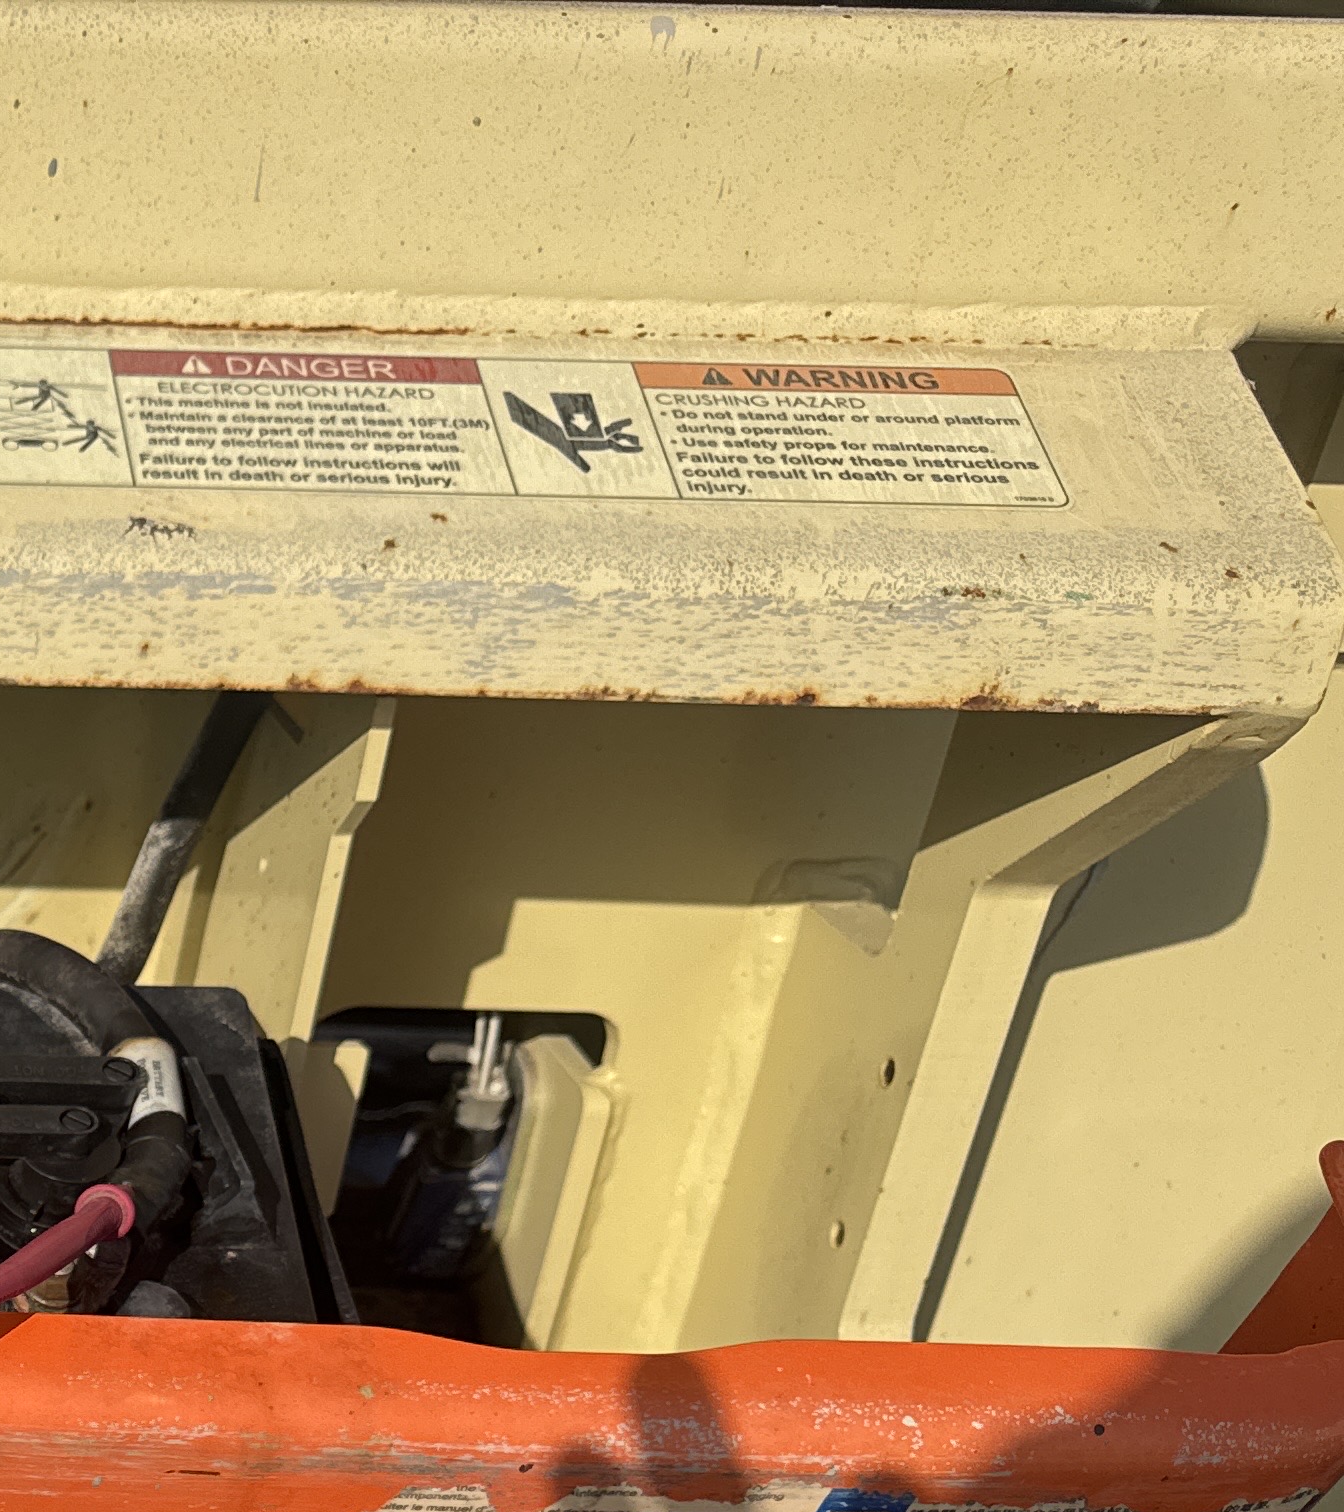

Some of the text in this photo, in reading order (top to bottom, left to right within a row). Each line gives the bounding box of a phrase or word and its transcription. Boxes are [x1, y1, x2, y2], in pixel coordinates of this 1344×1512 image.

[226, 355, 397, 379] DANGER
[741, 367, 940, 390] WARNING
[157, 381, 435, 401] ELECTROCUTION HAZARD
[137, 396, 393, 413] This machine is not insulated.
[655, 392, 866, 410] CRUSHING HAZARD
[139, 411, 213, 422] Maintain
[217, 413, 228, 423] a
[232, 413, 314, 424] clearance
[319, 415, 336, 425] of
[341, 416, 357, 426] at
[362, 417, 405, 427] least
[671, 408, 1021, 427] Do not stand under or around platform
[145, 423, 458, 441] between any part of machine or load
[676, 424, 834, 436] during operation.
[148, 436, 465, 454] and any electrical lines or apparatus.
[681, 437, 996, 454] Use safety props for maintenance.
[139, 453, 461, 472] Failure to follow instructions will
[675, 451, 1040, 470] Failure to follow these instructions
[141, 469, 458, 489] result in death or serious injury.
[682, 466, 1011, 484] could result in death or serious
[686, 481, 753, 496] injury.
